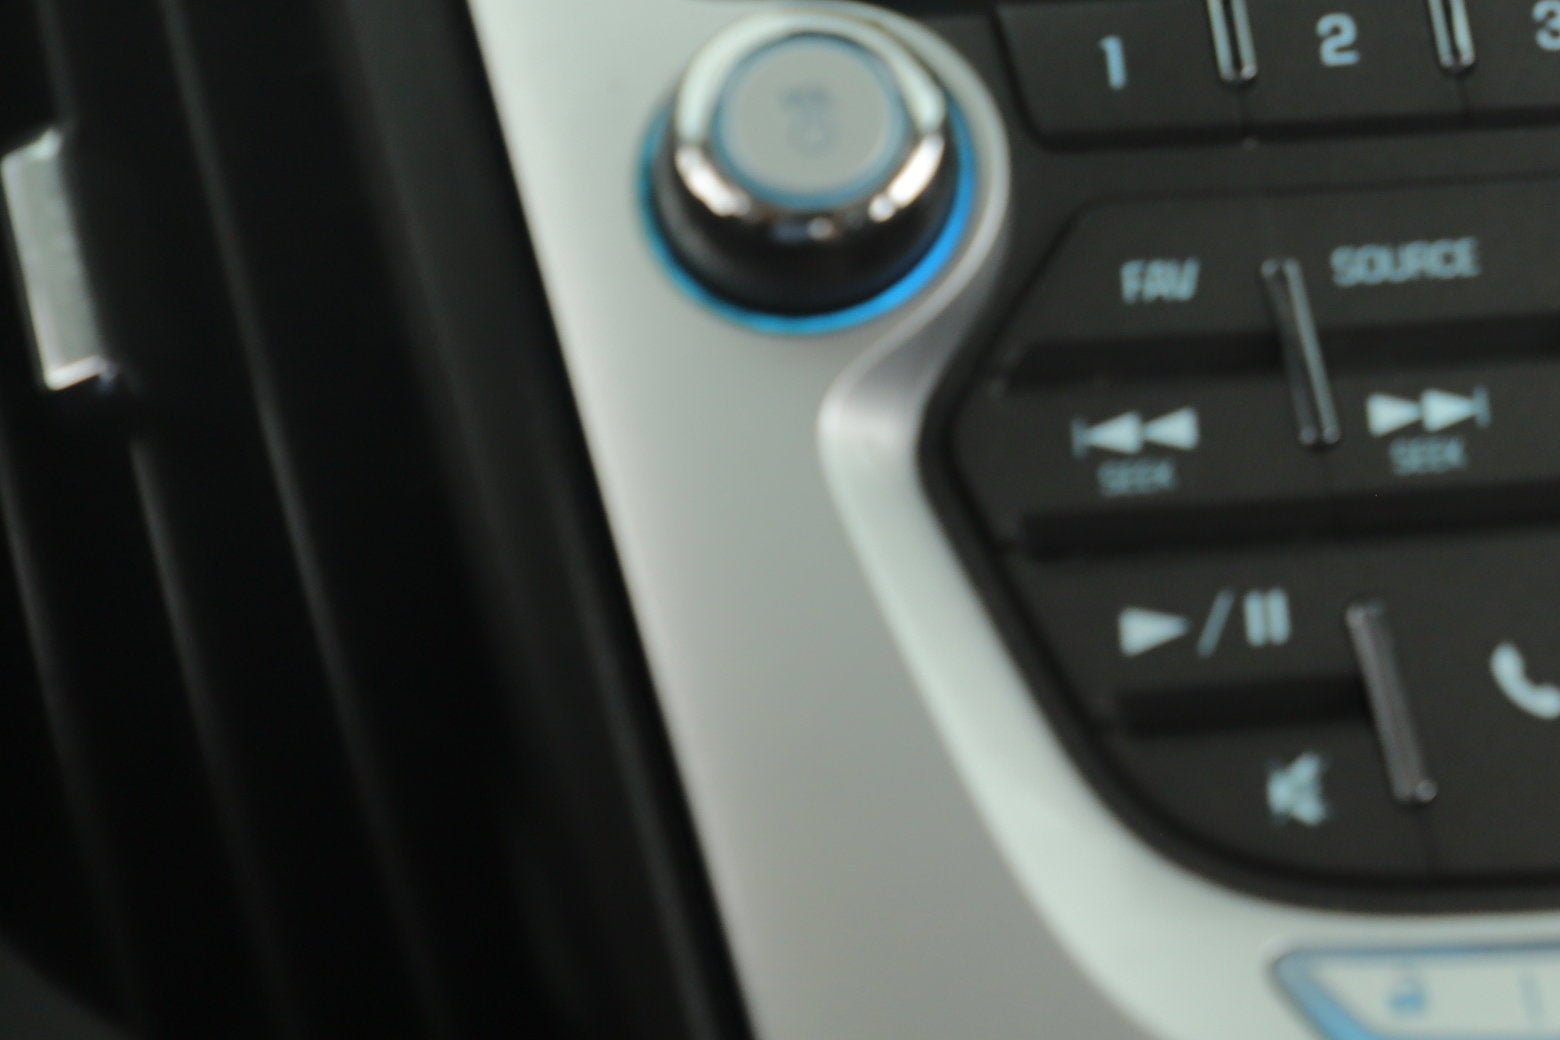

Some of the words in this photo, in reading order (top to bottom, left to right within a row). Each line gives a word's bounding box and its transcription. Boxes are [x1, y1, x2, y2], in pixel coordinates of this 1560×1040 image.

[1100, 35, 1127, 90] 1
[1316, 13, 1360, 67] 2
[1119, 259, 1199, 303] FAV
[1330, 236, 1480, 288] SOURCE
